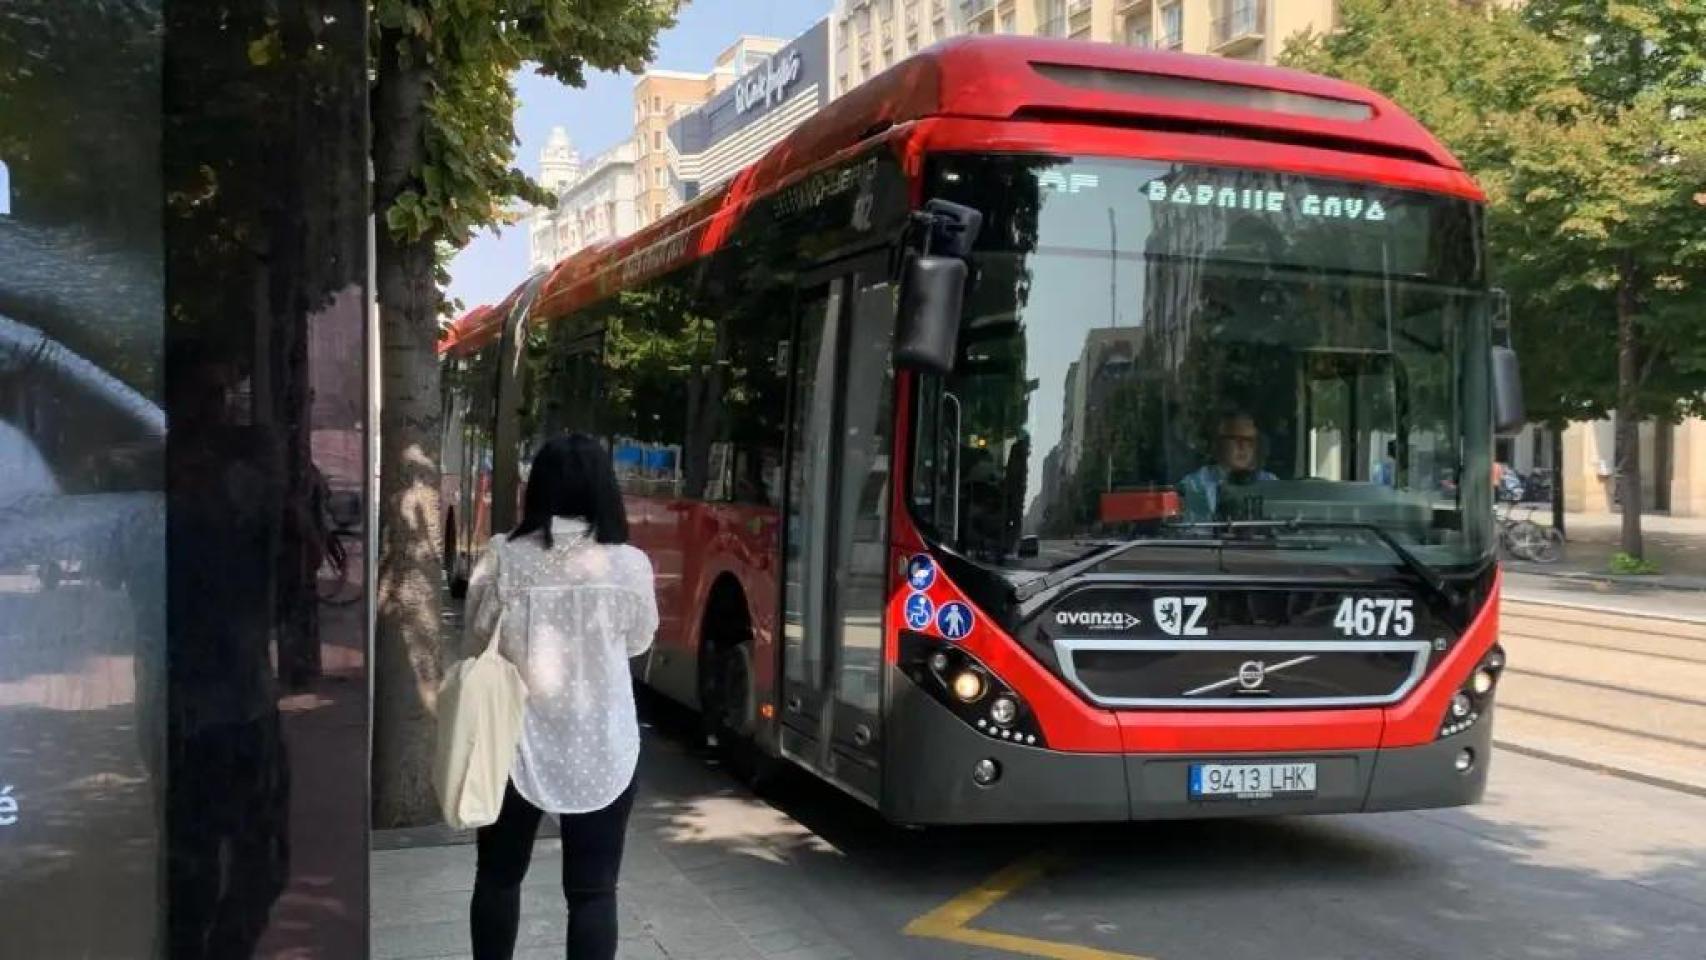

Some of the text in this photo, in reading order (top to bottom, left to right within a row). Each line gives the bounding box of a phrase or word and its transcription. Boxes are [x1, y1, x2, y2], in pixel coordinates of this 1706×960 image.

[1056, 610, 1124, 624] avanza
[1333, 597, 1414, 636] 4675
[1208, 766, 1307, 791] 9413 LHK
